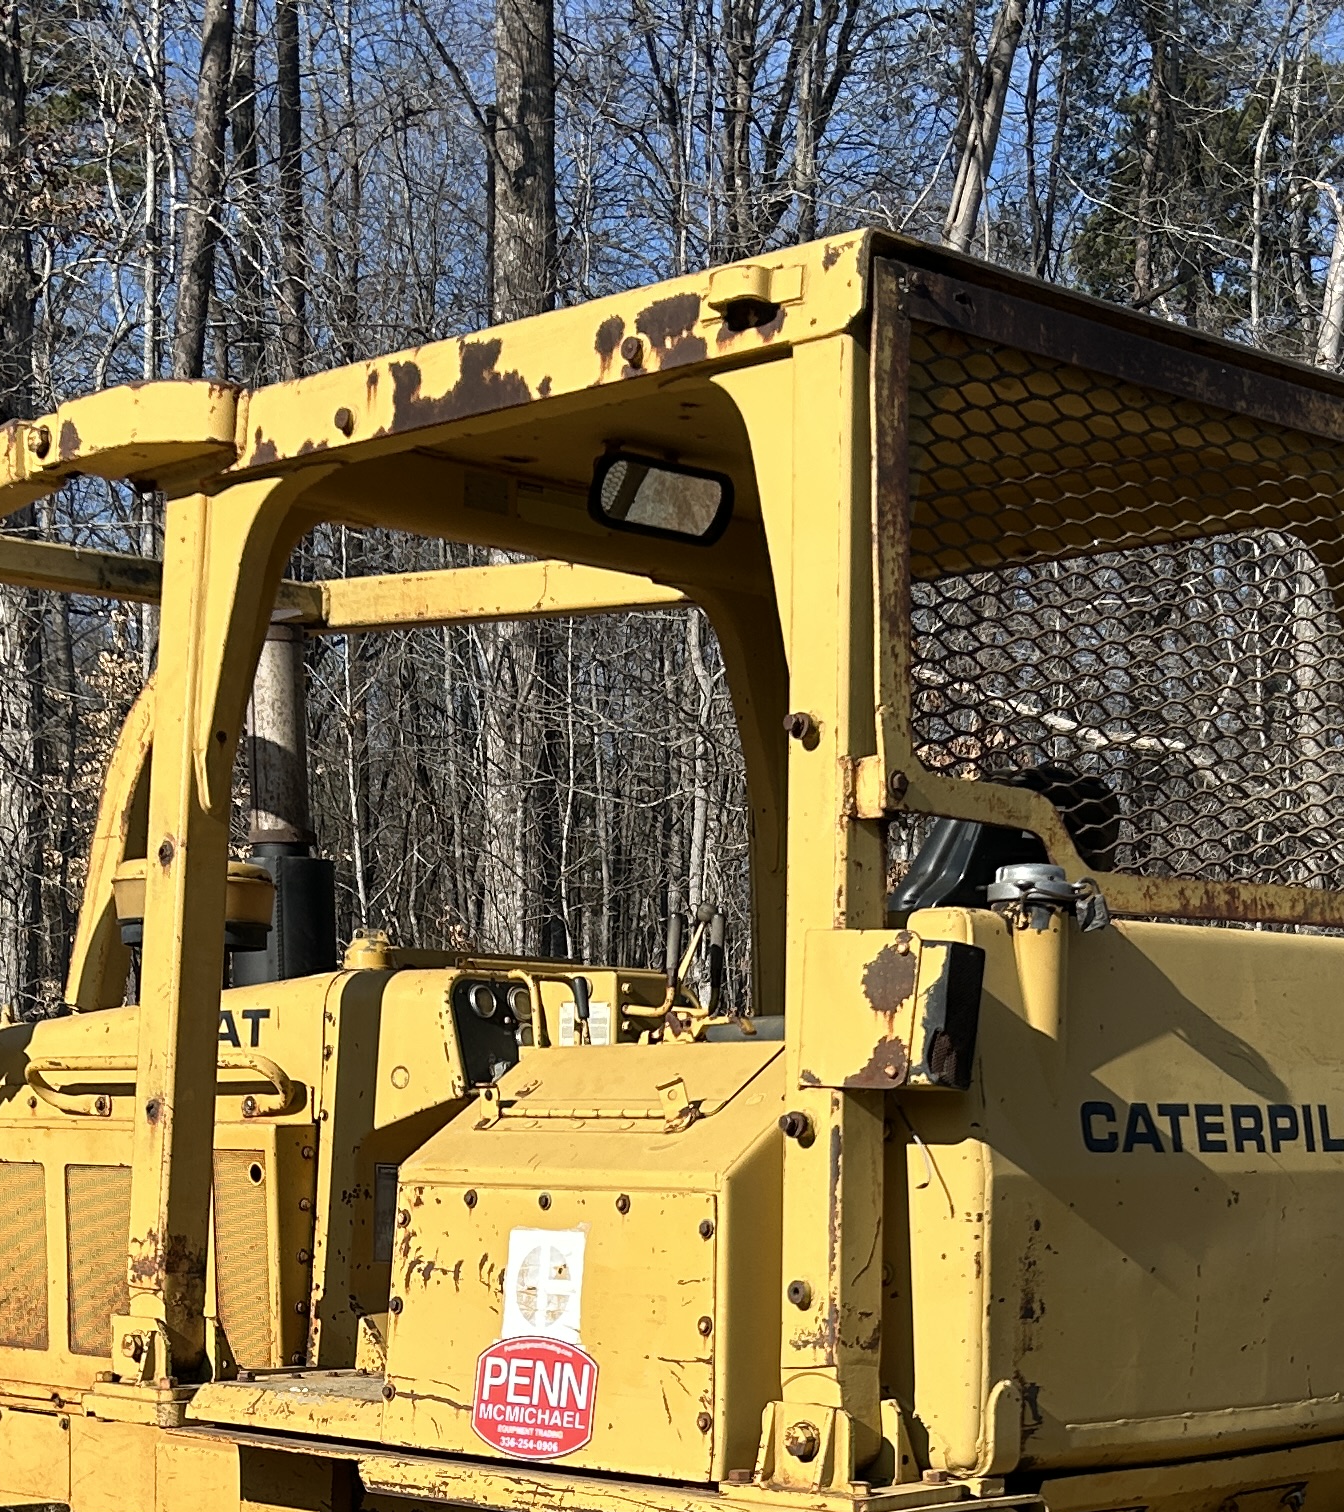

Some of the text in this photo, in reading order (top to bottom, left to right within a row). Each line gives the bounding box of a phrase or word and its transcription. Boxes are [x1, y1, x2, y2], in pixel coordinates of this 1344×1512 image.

[218, 1008, 271, 1048] AT
[482, 1355, 591, 1410] PENN
[478, 1403, 586, 1430] MCMICHAEL
